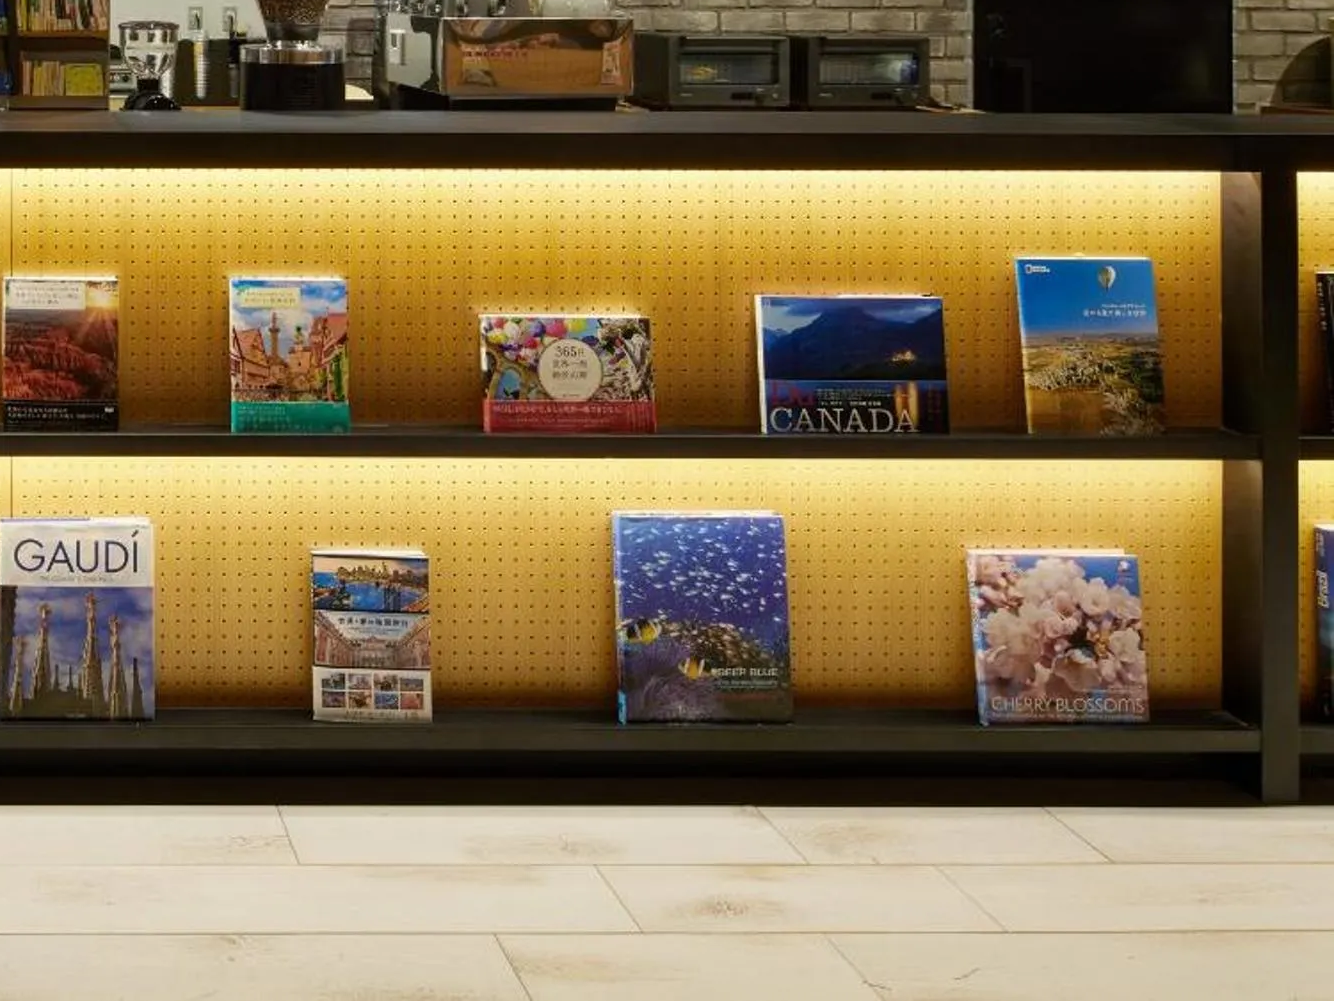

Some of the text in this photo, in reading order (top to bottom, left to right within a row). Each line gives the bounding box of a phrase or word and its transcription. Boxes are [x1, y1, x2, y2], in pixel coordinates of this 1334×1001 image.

[769, 406, 920, 433] CANADA
[14, 530, 139, 573] GAUDÍ
[991, 695, 1051, 712] CHERRY
